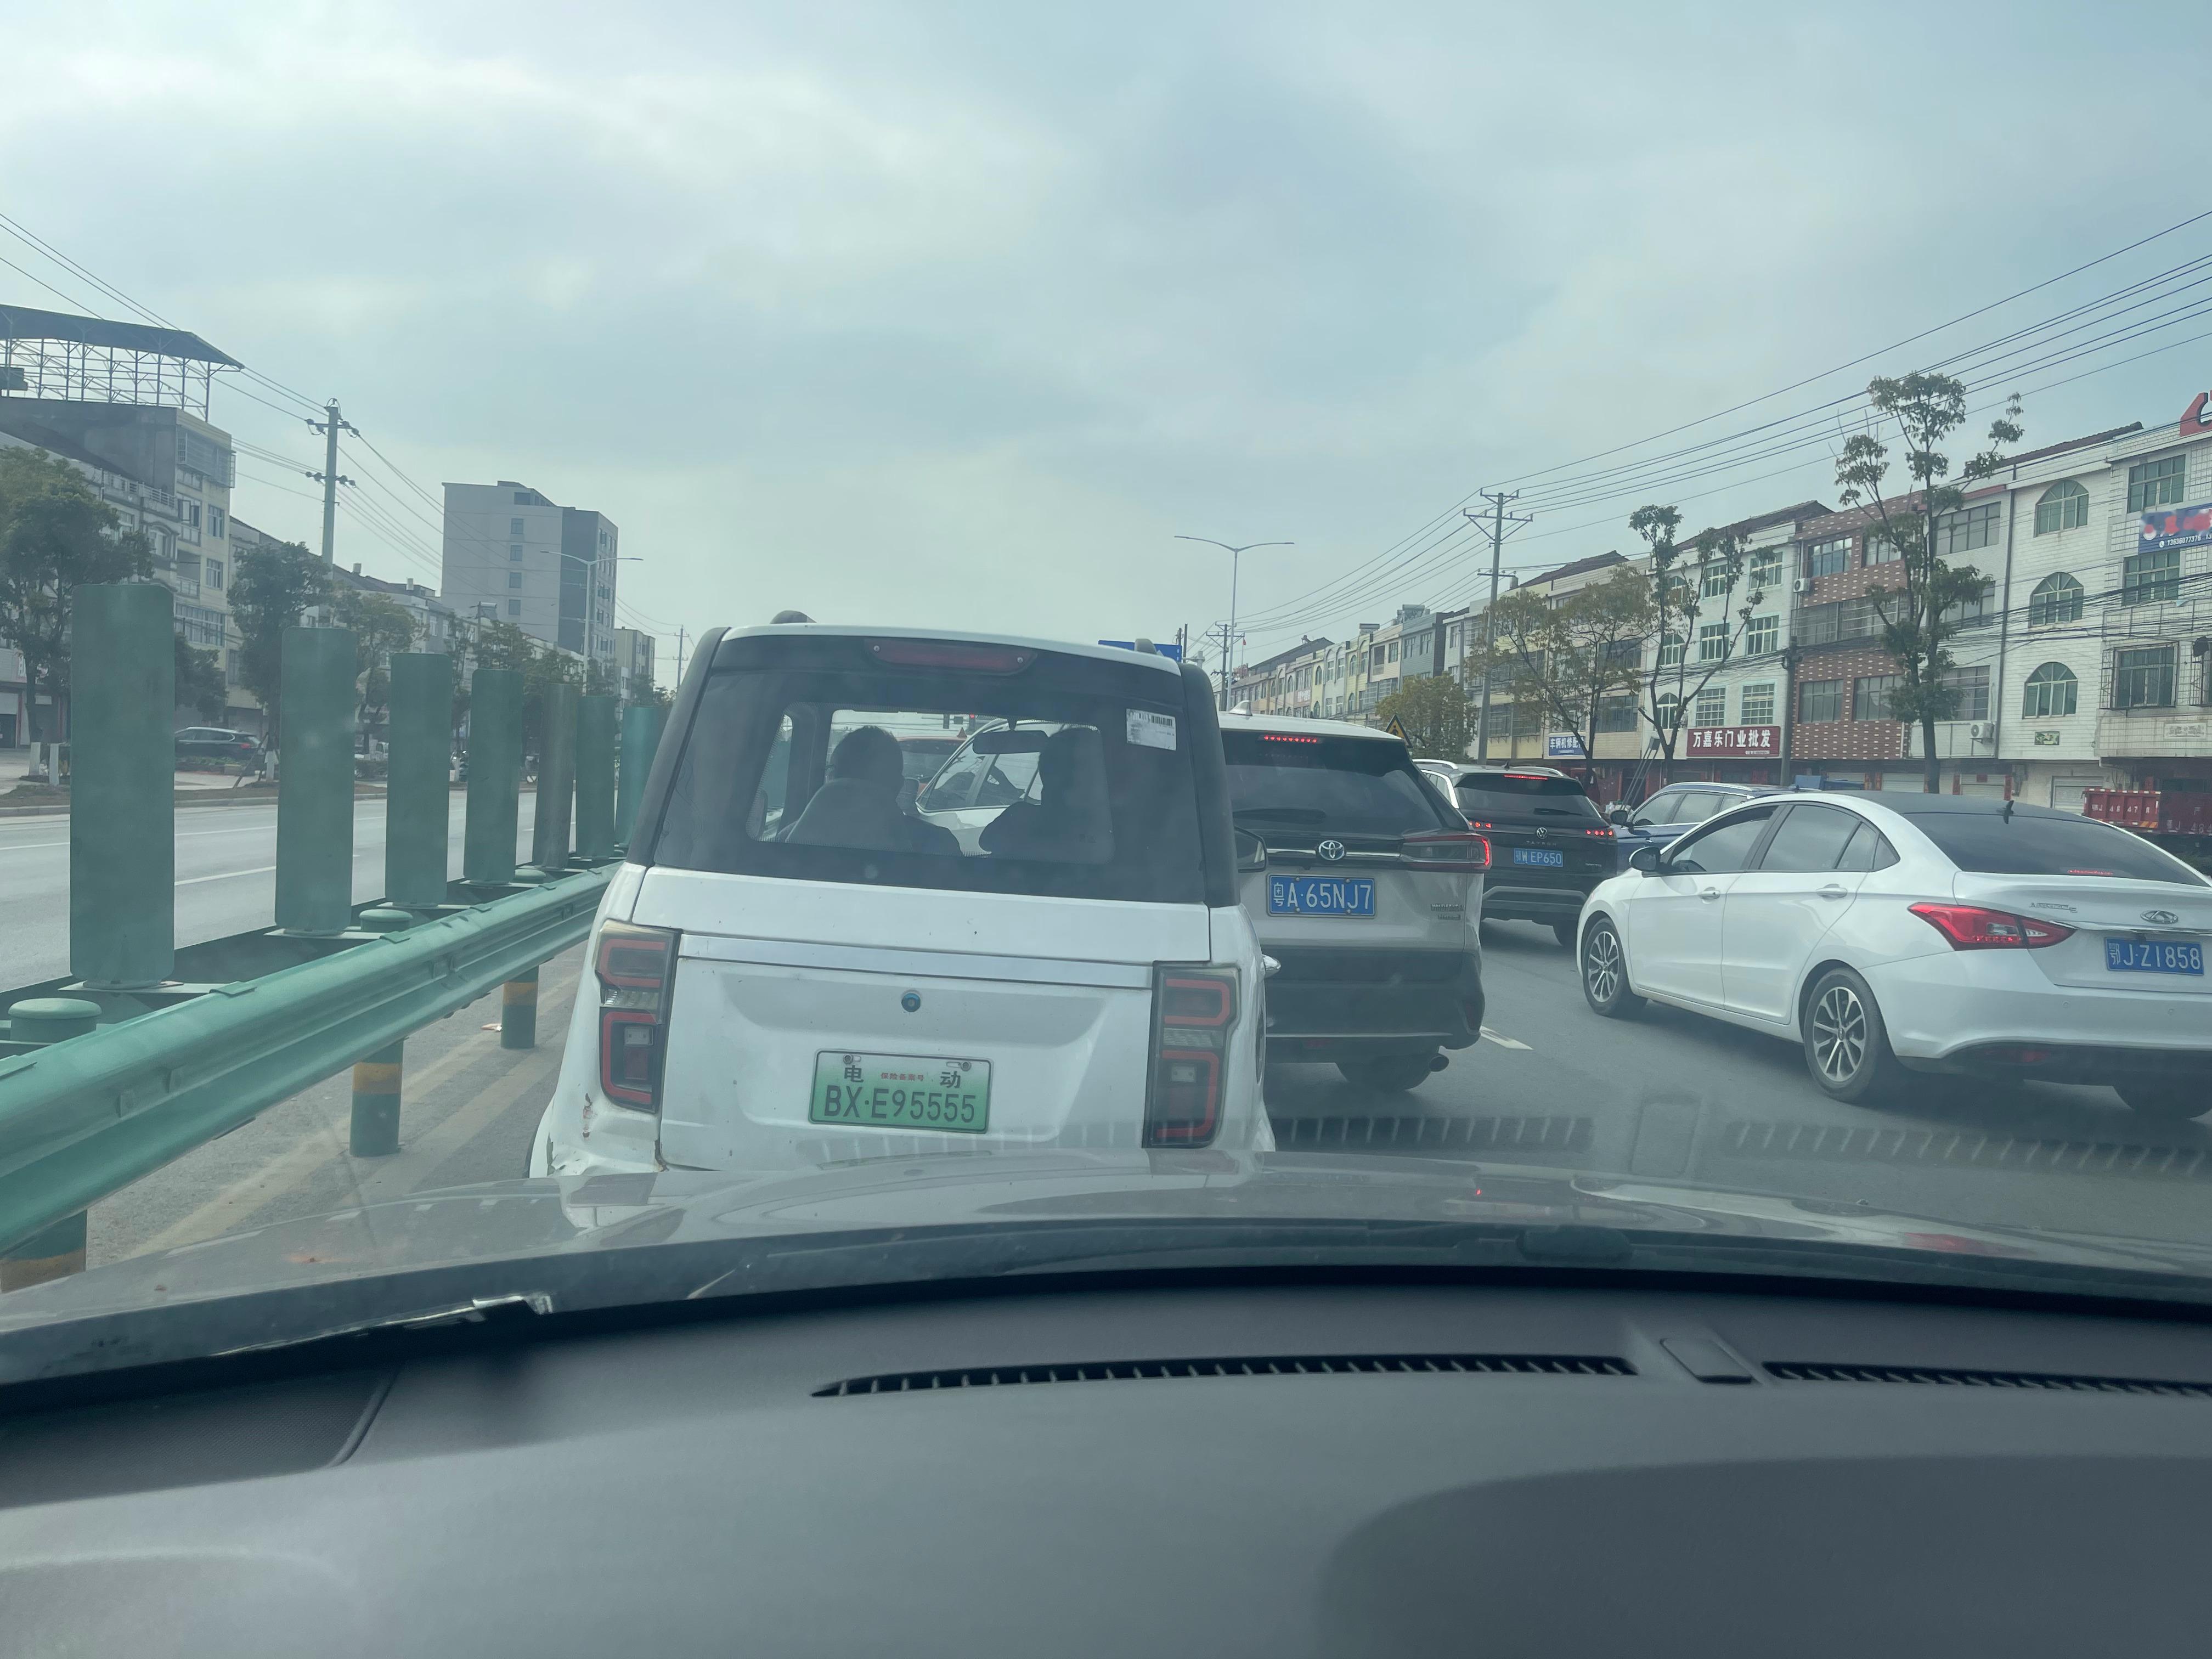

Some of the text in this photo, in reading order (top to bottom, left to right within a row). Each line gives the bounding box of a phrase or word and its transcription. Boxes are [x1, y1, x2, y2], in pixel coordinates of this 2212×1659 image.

[1550, 737, 1584, 749] 车辆机修配
[1693, 729, 1771, 748] 万嘉乐门业批发
[844, 1065, 864, 1083] 电
[940, 1071, 961, 1088] 动
